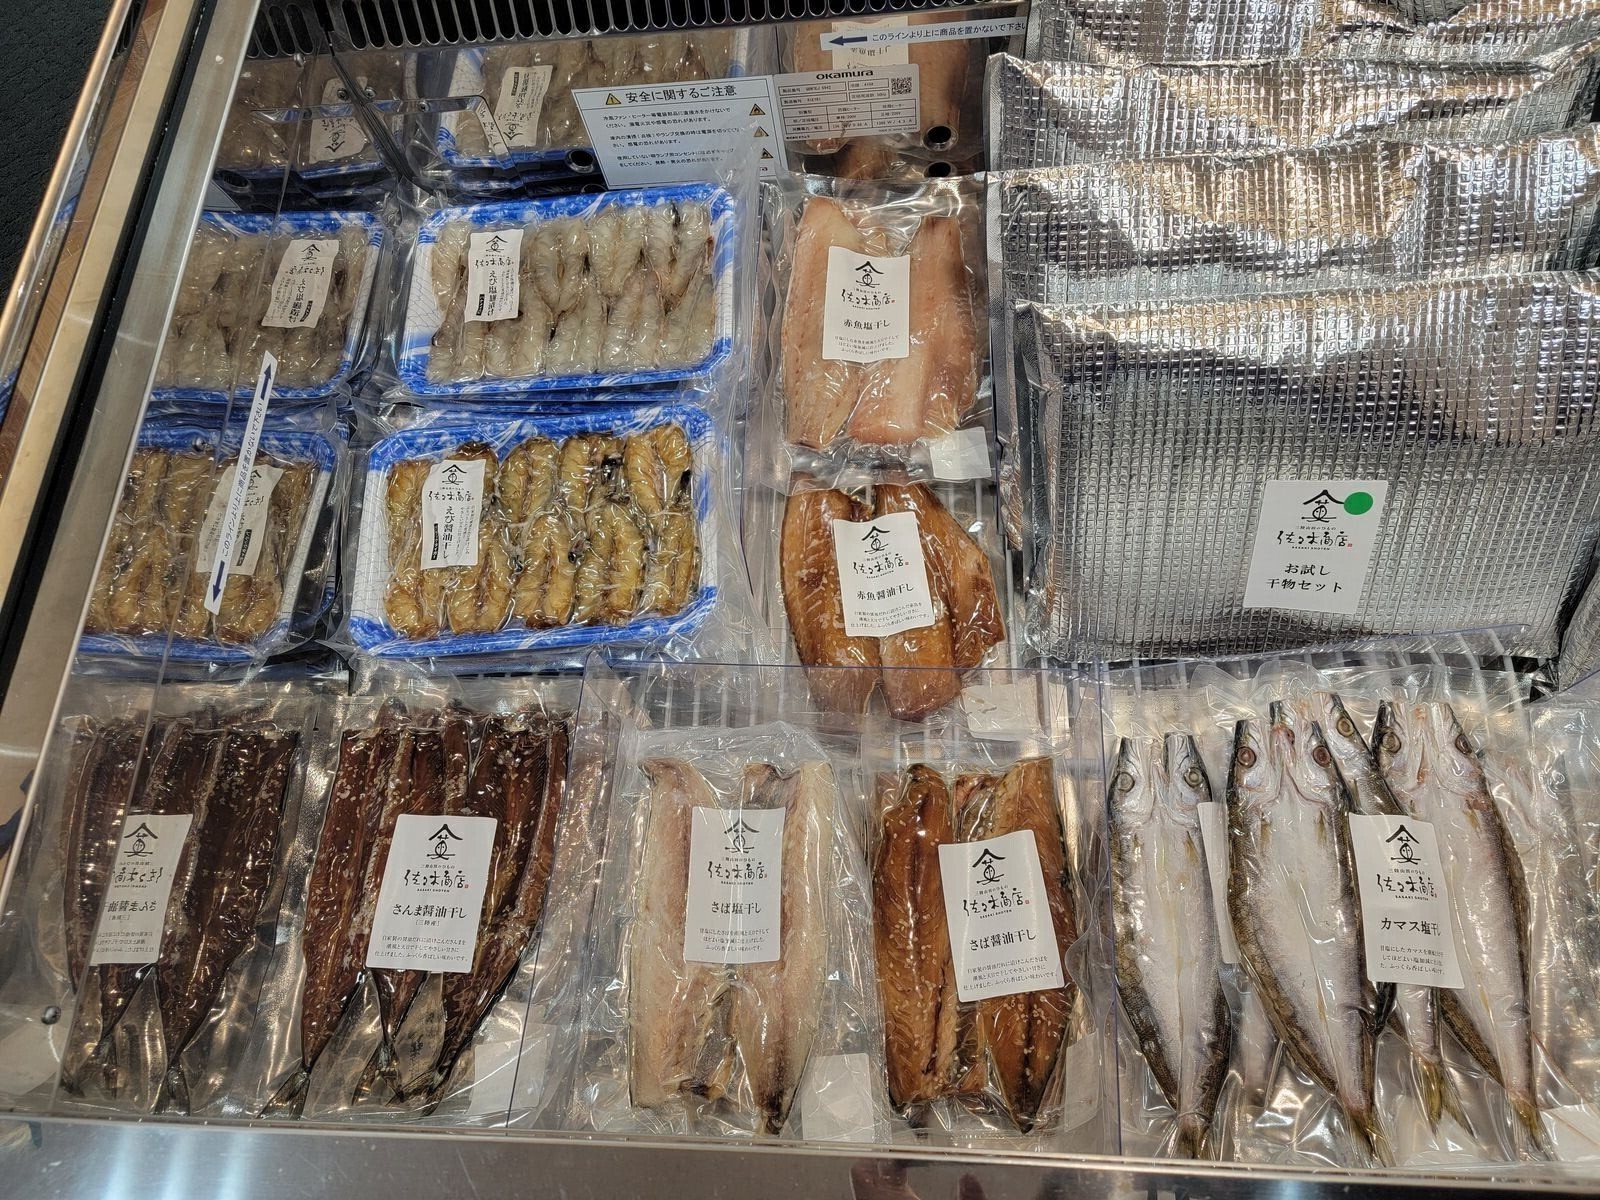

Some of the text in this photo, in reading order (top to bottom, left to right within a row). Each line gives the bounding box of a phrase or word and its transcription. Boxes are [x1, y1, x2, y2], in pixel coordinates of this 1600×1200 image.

[625, 85, 737, 104] 安全に関するご注意
[843, 319, 890, 331] 赤魚塩干し
[1284, 563, 1330, 576] お試し
[856, 583, 914, 601] 赤魚醤油干し
[1265, 578, 1342, 593] 干物セット
[392, 904, 469, 919] さんま醤油干し
[711, 901, 762, 915] さば塩干し
[969, 929, 1037, 951] さば醤油干し
